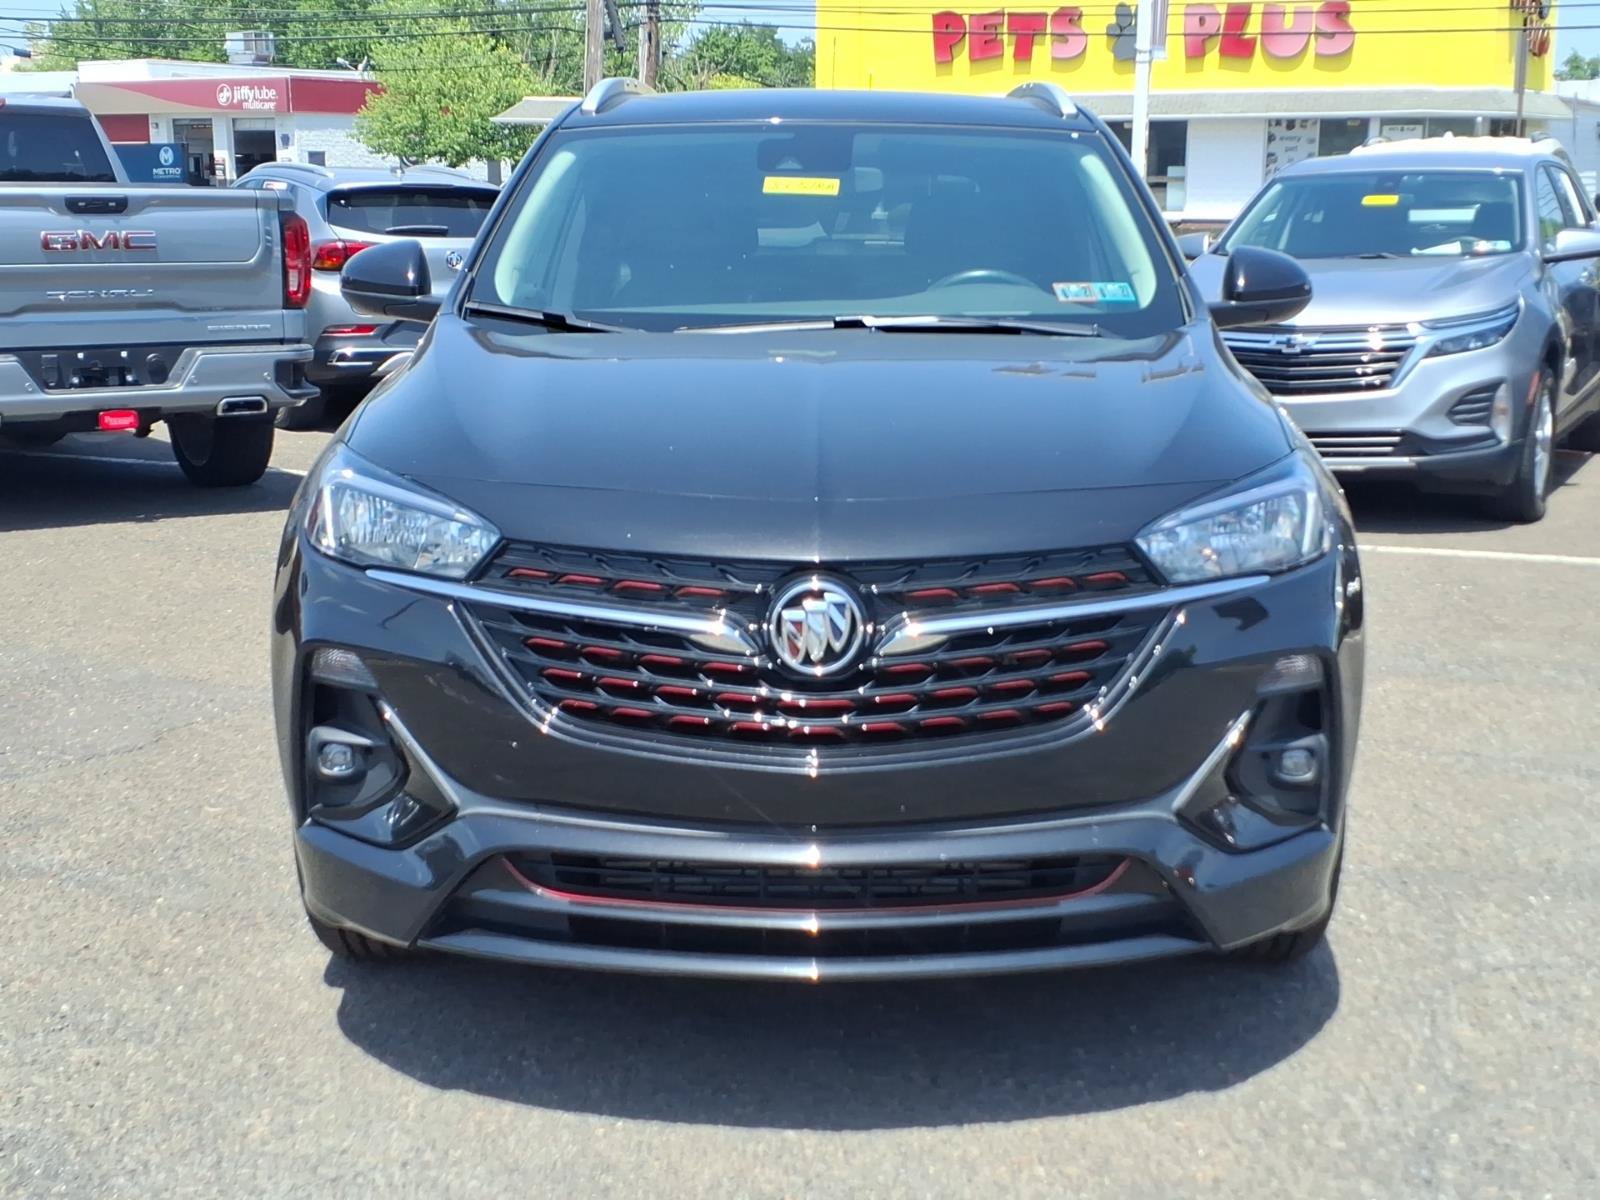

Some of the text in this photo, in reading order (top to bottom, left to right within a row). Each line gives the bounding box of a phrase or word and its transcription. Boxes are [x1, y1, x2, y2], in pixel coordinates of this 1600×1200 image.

[932, 1, 1356, 65] PETS PLUS
[152, 167, 181, 175] METRO
[40, 229, 157, 251] GMC
